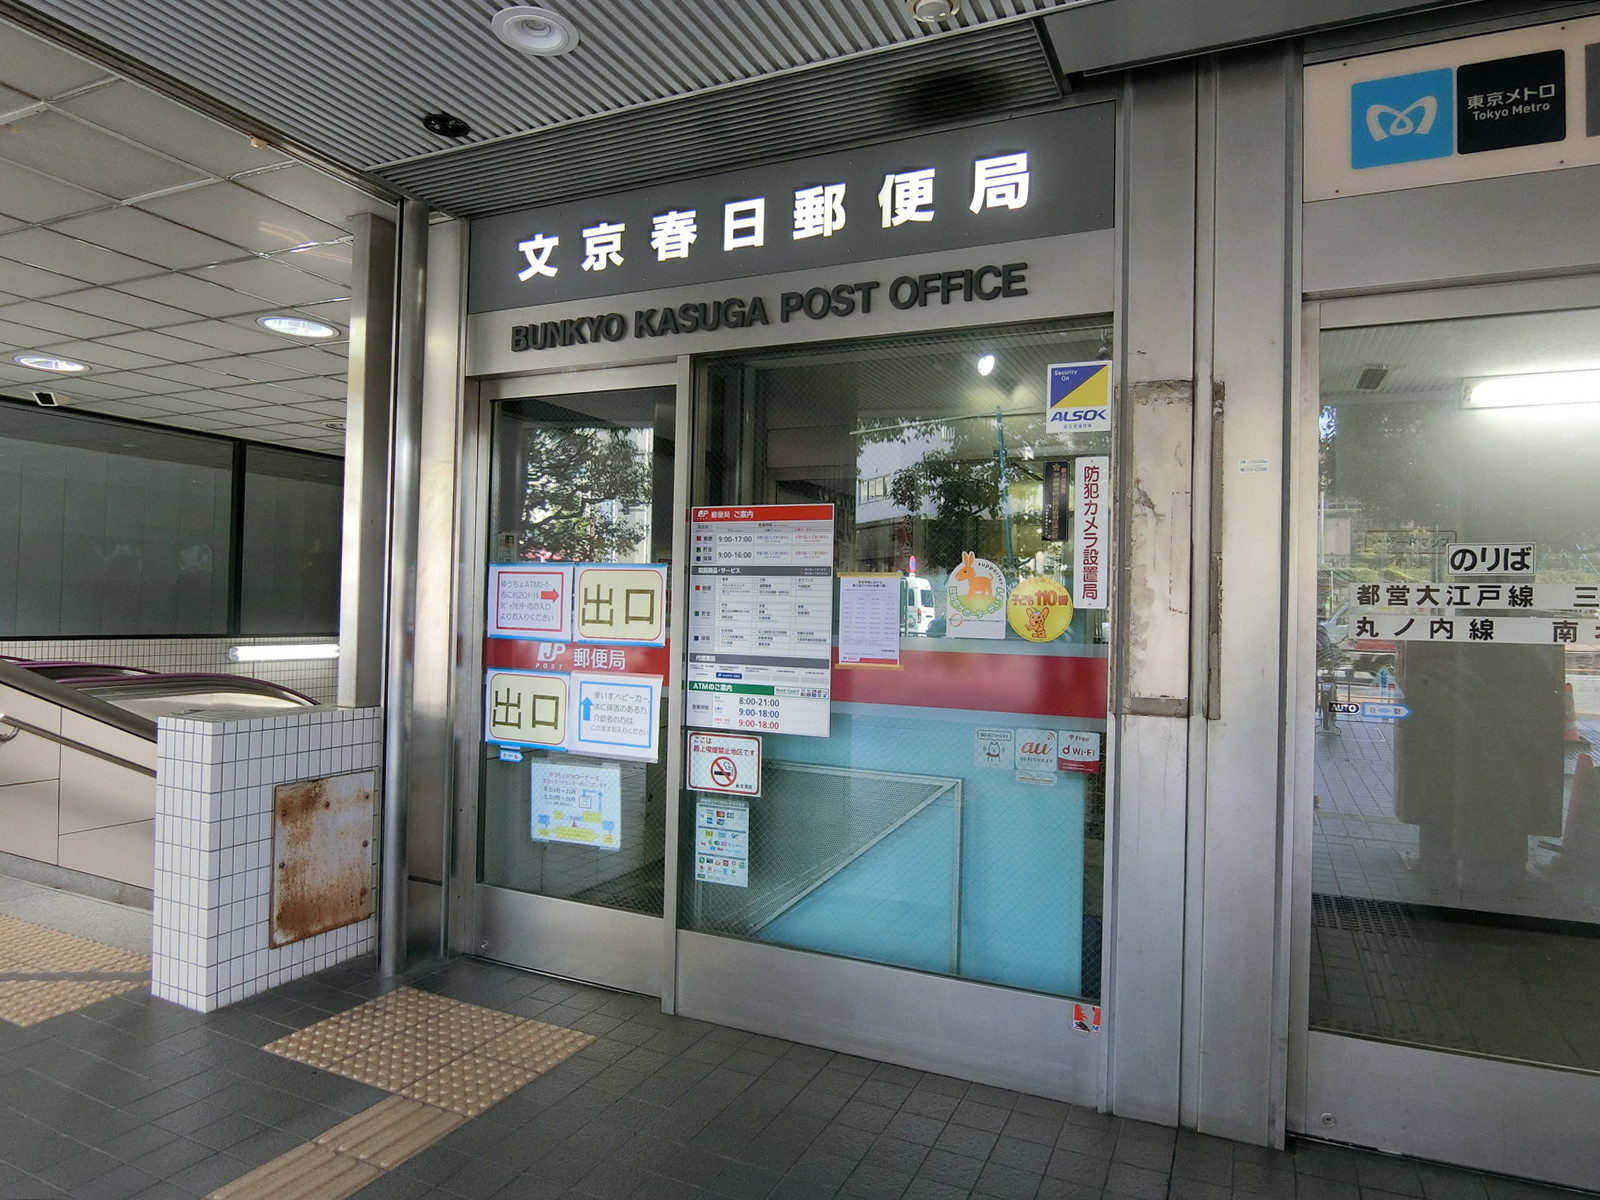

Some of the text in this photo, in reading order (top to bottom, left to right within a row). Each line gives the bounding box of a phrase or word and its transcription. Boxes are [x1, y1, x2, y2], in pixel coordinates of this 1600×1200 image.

[1467, 84, 1555, 111] 東京メトロ
[1473, 102, 1550, 121] Tokyo Metro
[517, 151, 1031, 283] 文京春日郵便局
[511, 262, 1028, 352] BUNKYO KASUGA POST OFFICE
[1050, 409, 1107, 422] ALSOK
[1082, 465, 1100, 601] 防犯カメラ設置局
[1450, 546, 1532, 572] のりば
[978, 562, 1004, 585] supporter
[582, 583, 655, 626] 出口
[1357, 584, 1534, 608] 都営大江戸線
[1355, 616, 1600, 643] 丸ノ内線 南
[537, 642, 566, 662] JP
[573, 647, 626, 670] 郵便局
[693, 682, 733, 692] ATMのご案内
[492, 687, 560, 730] 出口
[739, 697, 780, 707] 8:00-21:00
[1331, 703, 1357, 712] AUTO
[738, 708, 780, 718] 9:00-18:00
[738, 719, 780, 729] 9:00-18:00
[694, 736, 712, 744] ここは
[1021, 741, 1053, 755] au
[1072, 747, 1095, 757] Wi-Fi
